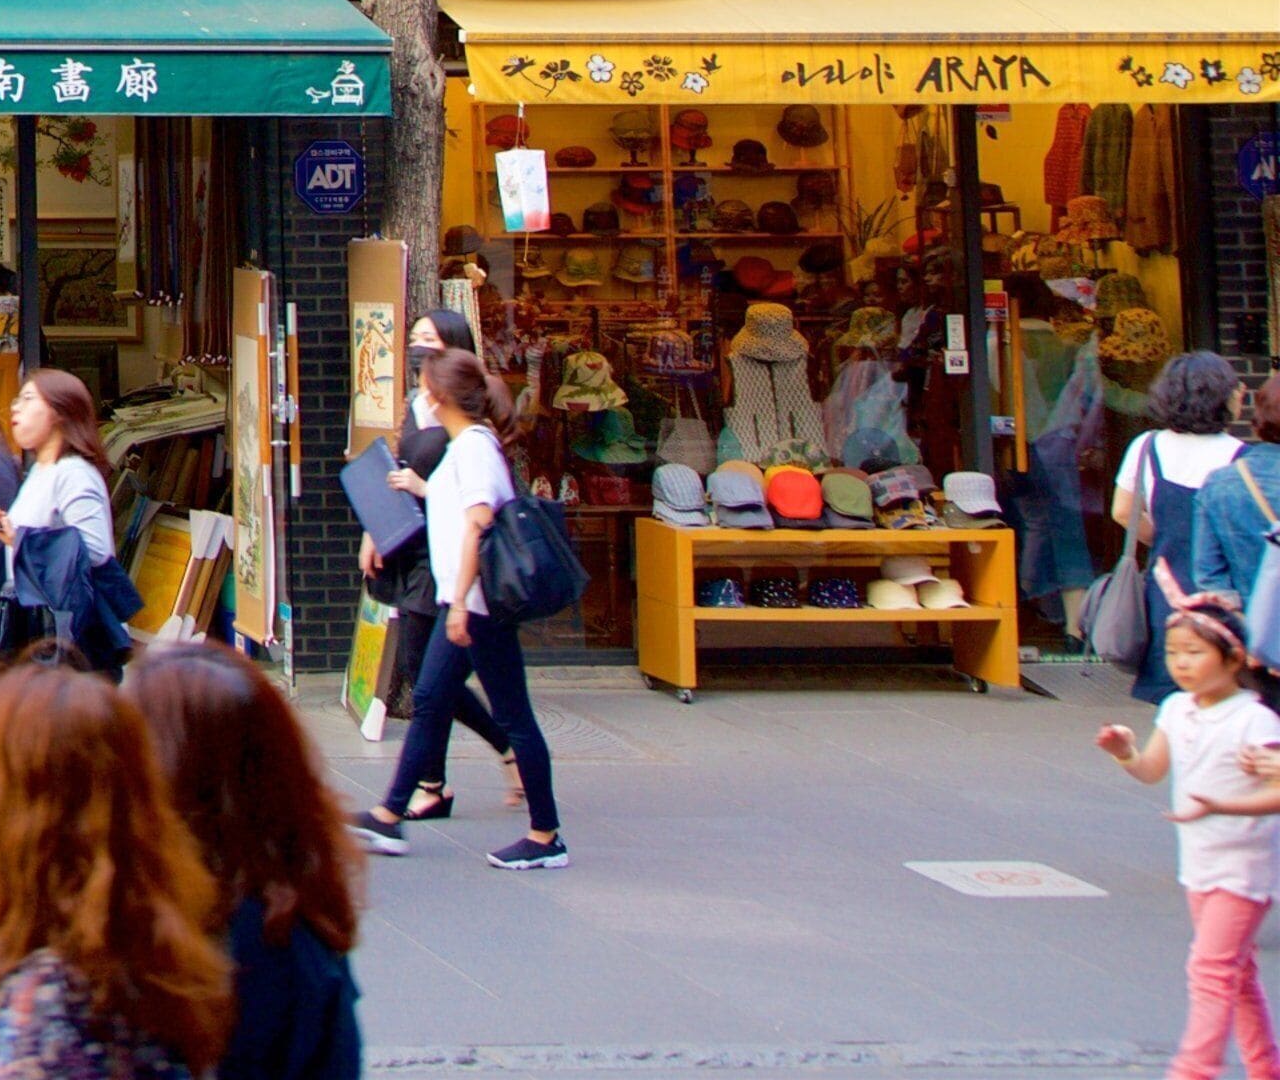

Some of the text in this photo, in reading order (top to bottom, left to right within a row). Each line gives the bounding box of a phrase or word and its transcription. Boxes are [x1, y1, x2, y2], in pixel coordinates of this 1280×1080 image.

[781, 53, 1051, 94] 아라야 ARAYA
[307, 163, 357, 190] ADT
